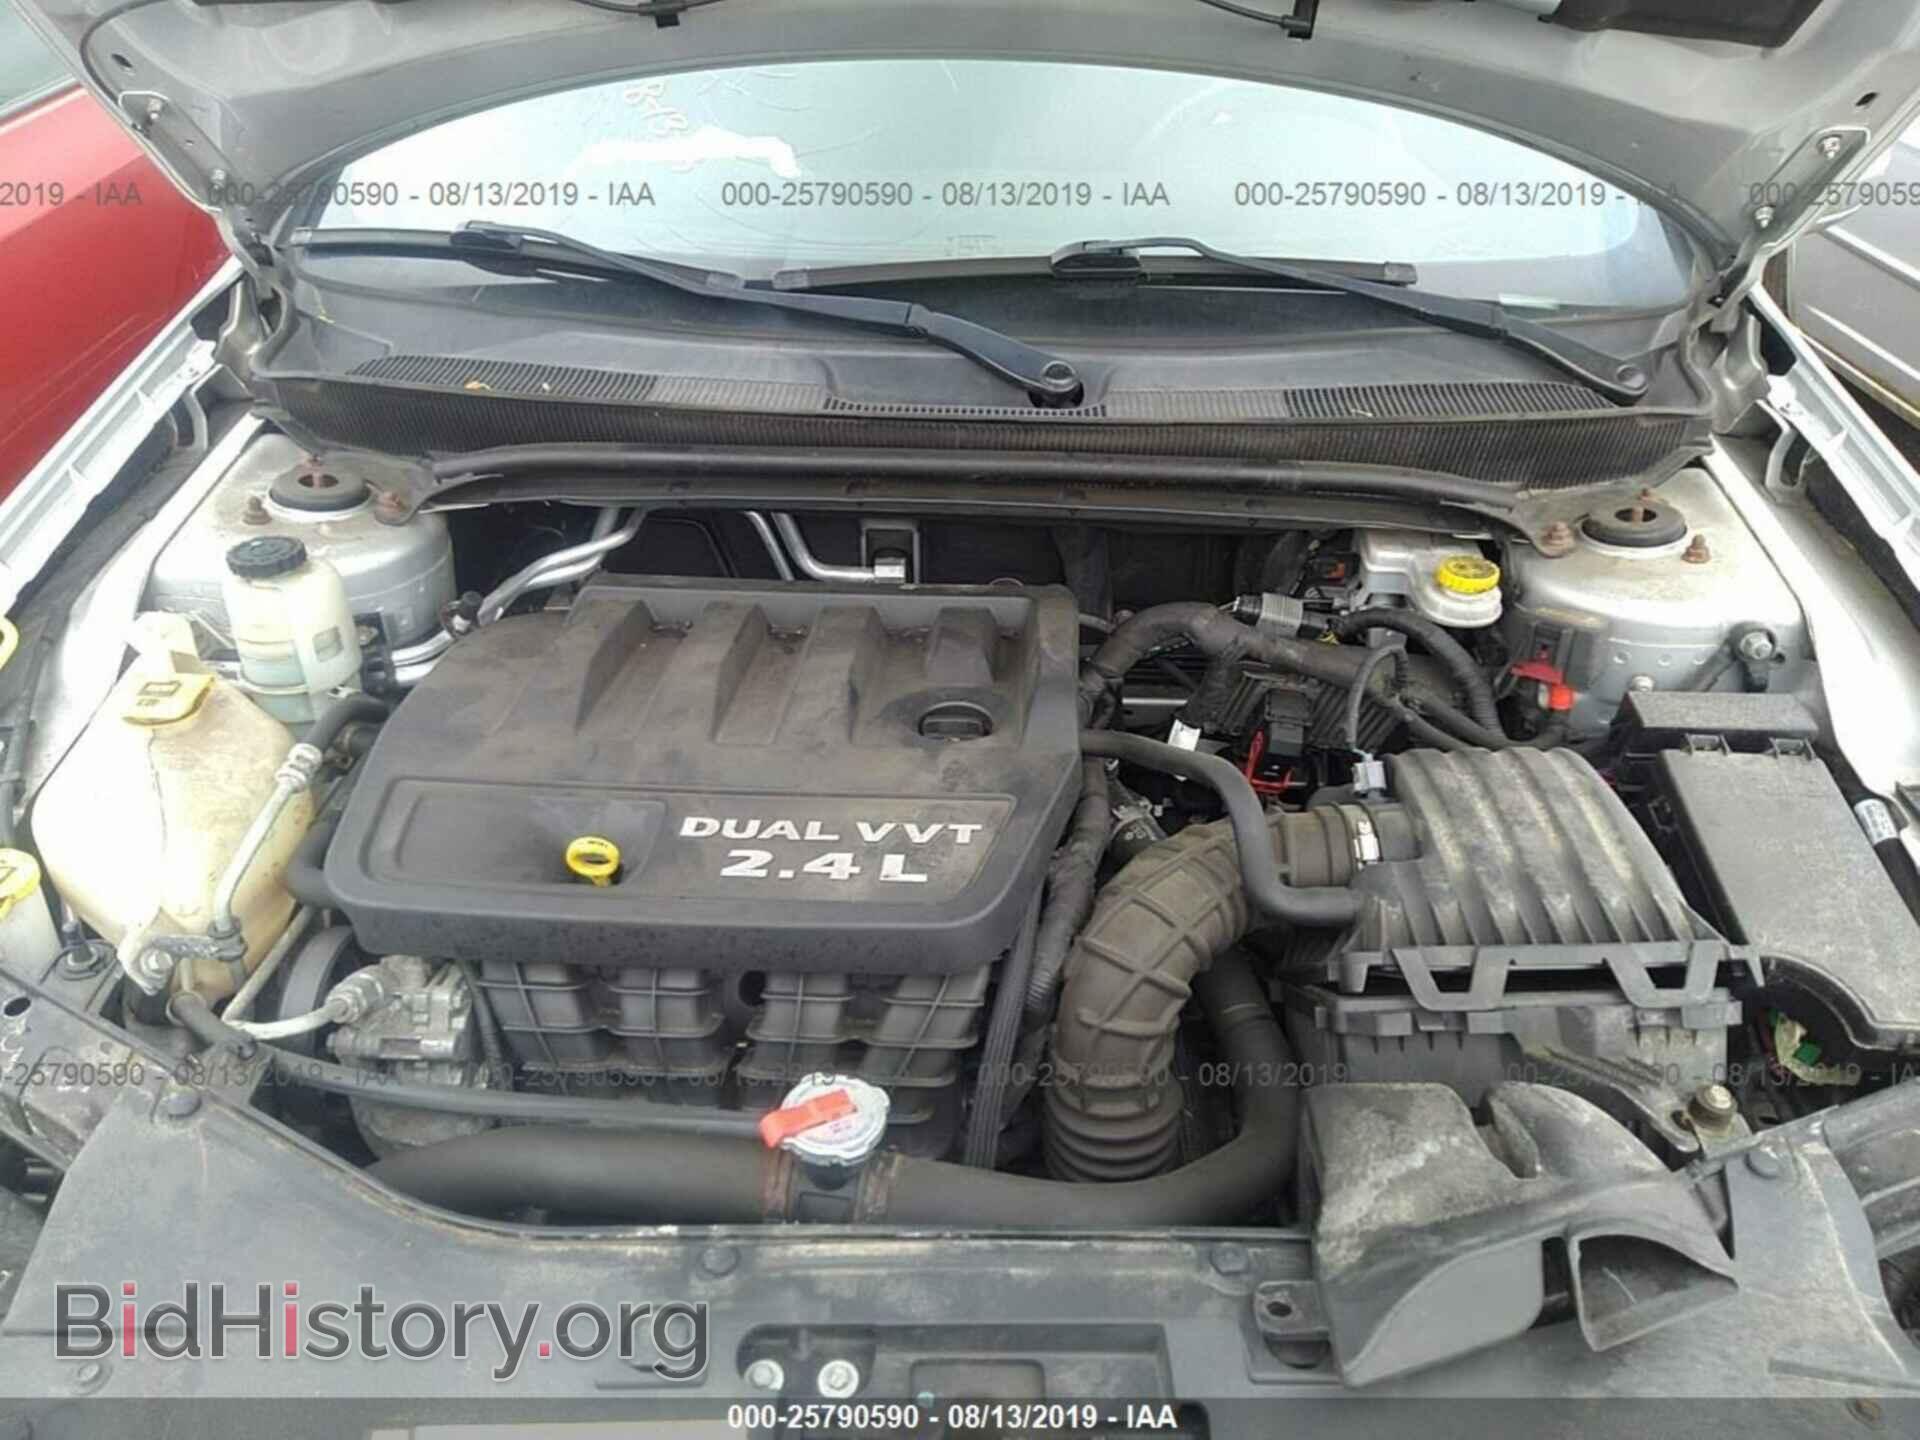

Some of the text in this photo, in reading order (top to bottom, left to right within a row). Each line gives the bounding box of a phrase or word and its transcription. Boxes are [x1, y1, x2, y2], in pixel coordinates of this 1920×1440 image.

[680, 816, 983, 843] DUAL VVT
[720, 850, 928, 882] 2.4 L
